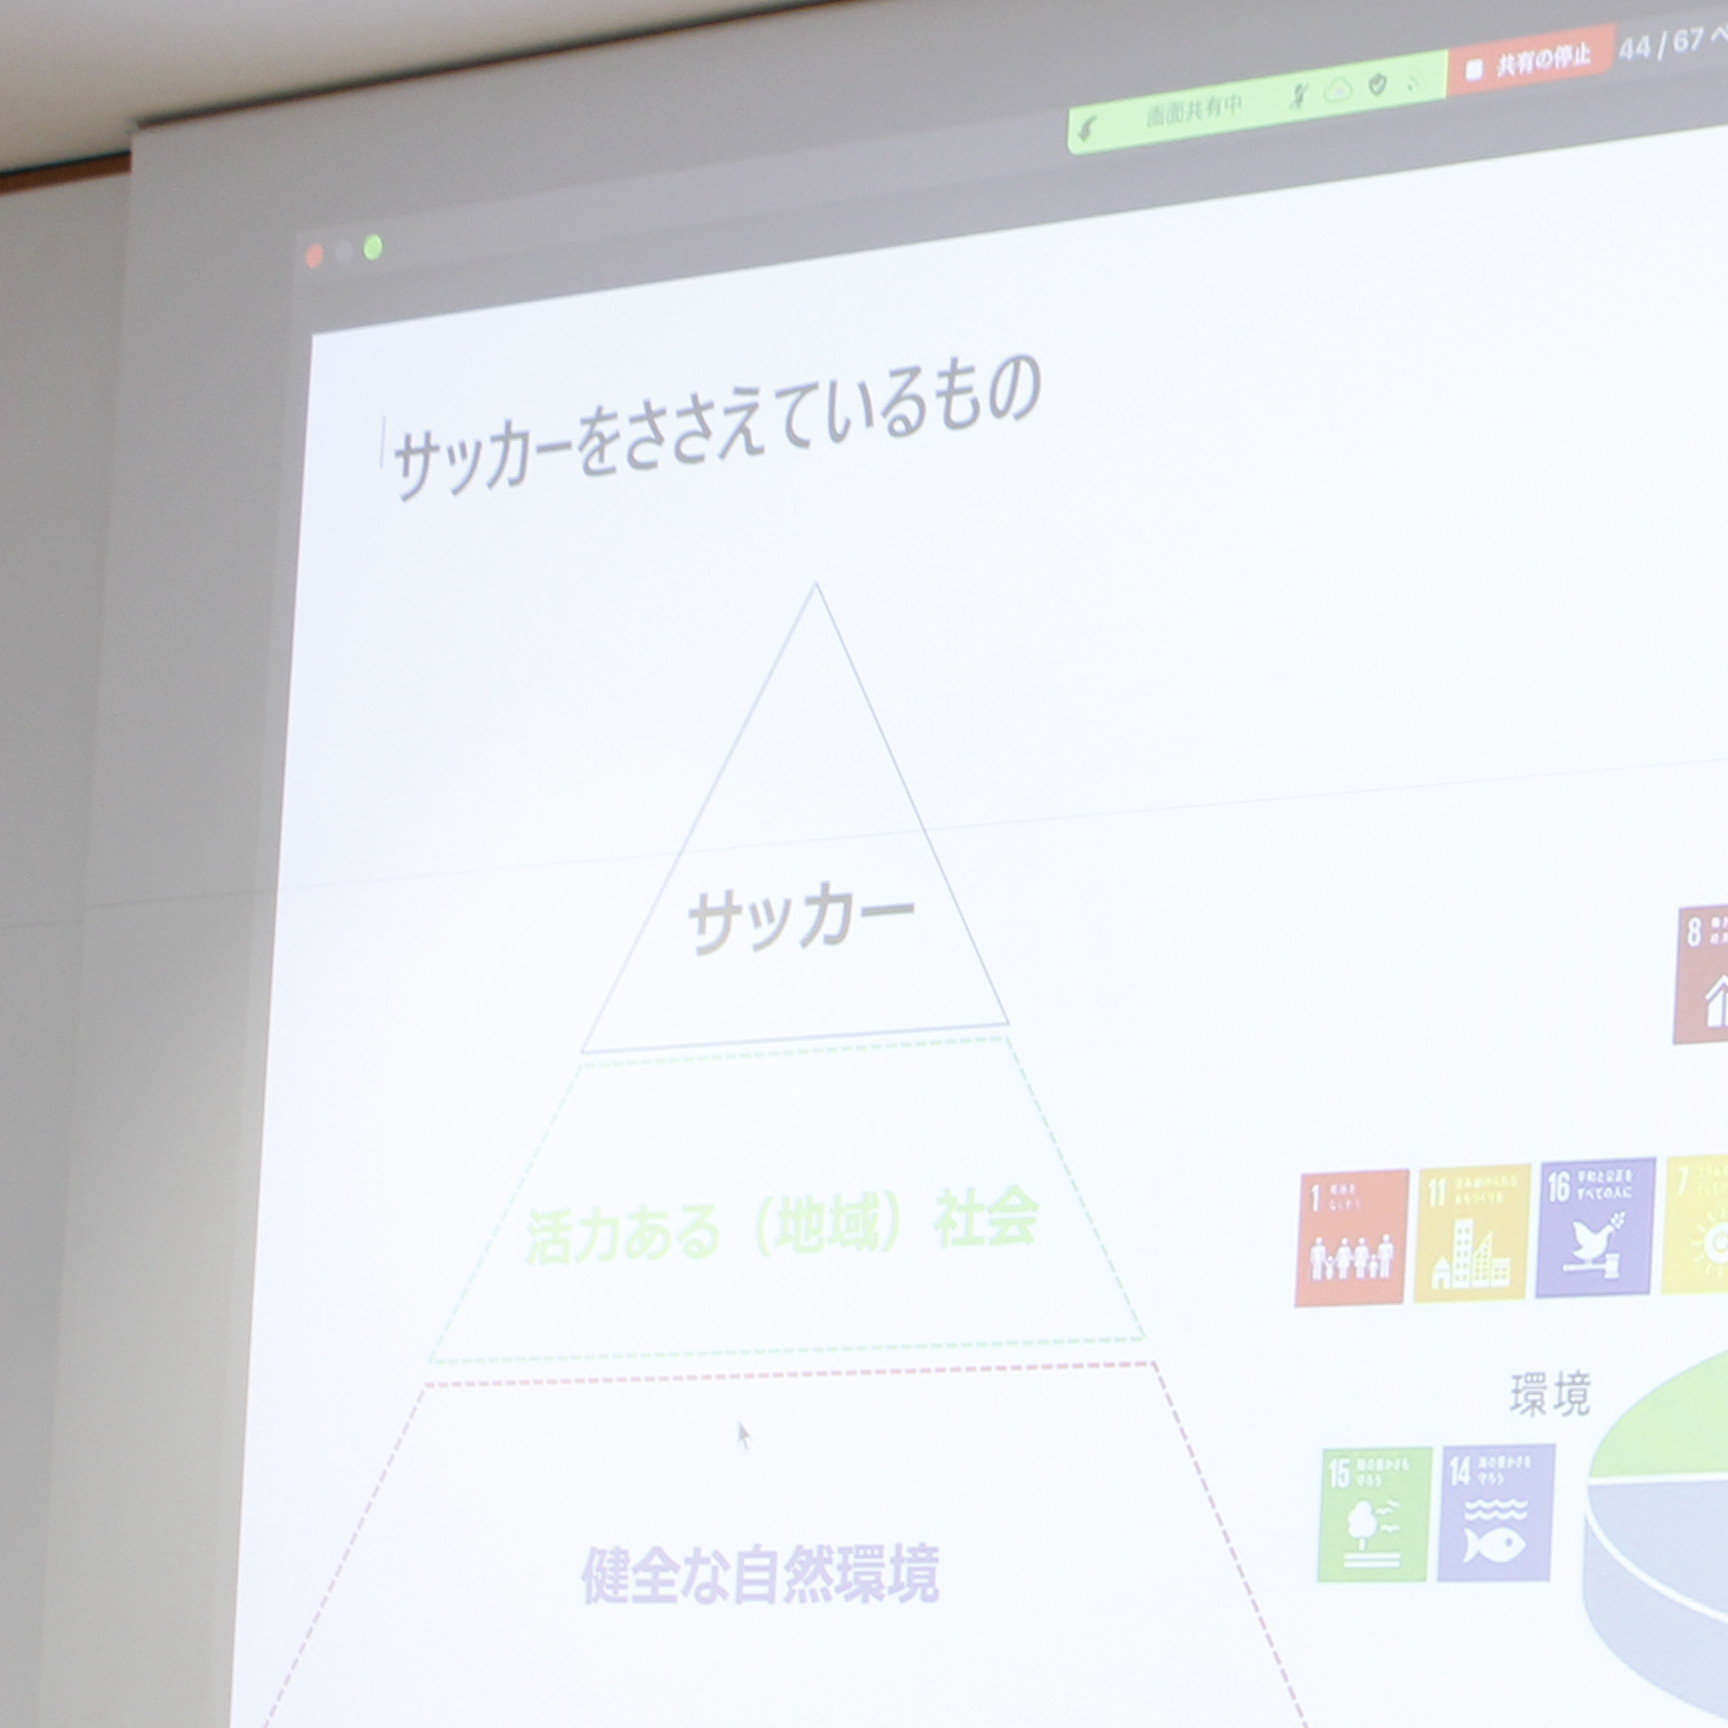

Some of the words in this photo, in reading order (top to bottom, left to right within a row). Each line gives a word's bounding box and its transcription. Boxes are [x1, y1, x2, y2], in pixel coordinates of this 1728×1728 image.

[1619, 37, 1650, 60] 44
[1673, 27, 1704, 52] 67
[1498, 42, 1591, 78] 共有の停止
[1147, 94, 1242, 128] 画面共有中
[394, 354, 1042, 502] サッカーをささえているもの
[689, 881, 915, 957] サッカー
[1688, 918, 1701, 946] 8
[1429, 1178, 1446, 1207] 11
[1549, 1172, 1570, 1201] 16
[1678, 1168, 1689, 1196] 7
[1312, 1185, 1320, 1212] 1
[1510, 1368, 1592, 1418] 環境
[1329, 1459, 1350, 1488] 15
[1450, 1456, 1471, 1485] 14
[580, 1543, 940, 1606] 健全な自然環境
